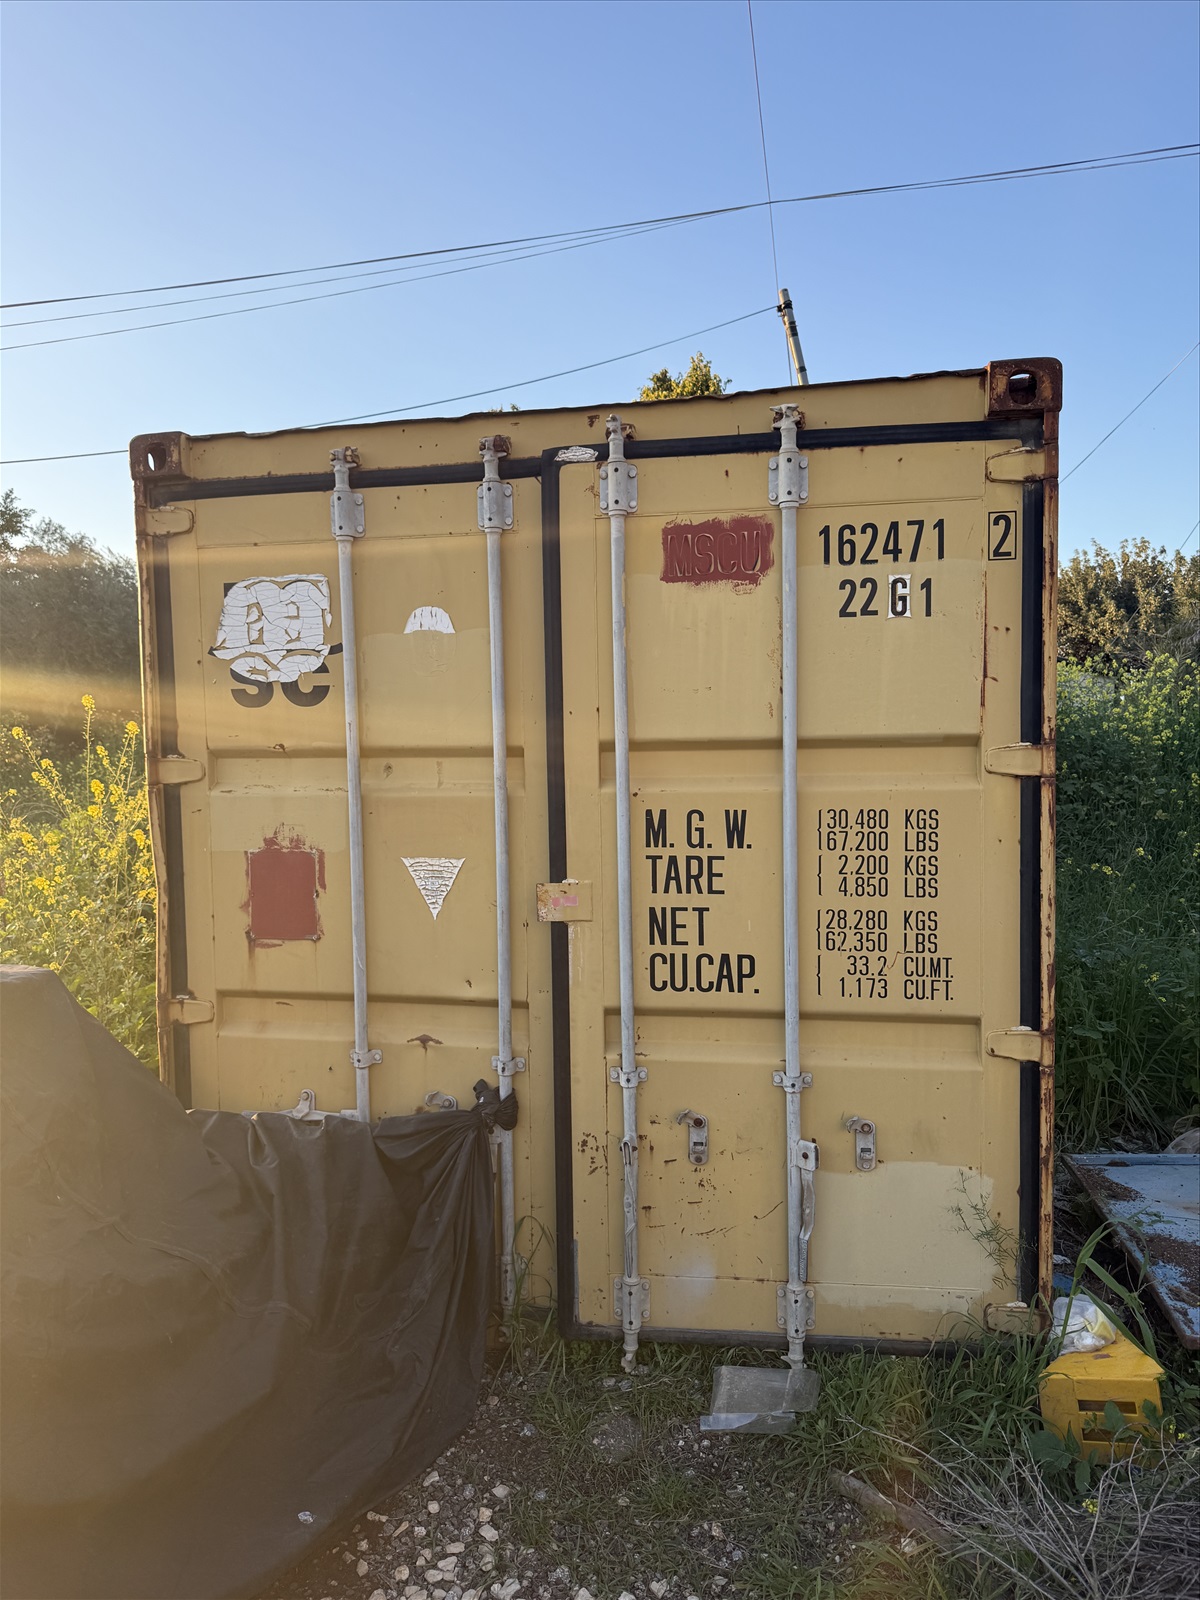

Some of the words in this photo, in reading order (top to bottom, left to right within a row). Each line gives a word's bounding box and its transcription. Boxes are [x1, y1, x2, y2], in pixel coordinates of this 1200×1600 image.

[667, 531, 761, 577] MSCU
[818, 518, 945, 566] 162471
[992, 513, 1013, 558] 2
[645, 809, 675, 849] M.
[686, 809, 713, 849] G.
[724, 809, 752, 849] W.
[826, 808, 889, 830] 30,480
[904, 808, 939, 830] KGS
[826, 830, 889, 852] 67,200
[904, 830, 939, 852] LBS
[645, 854, 725, 895] TARE
[838, 854, 889, 876] 2,200
[904, 855, 939, 876] KGS
[838, 876, 889, 898] 4,850
[904, 876, 939, 898] LBS
[648, 906, 710, 946] NET
[825, 908, 888, 931] 28,280
[903, 910, 938, 932] KGS
[825, 931, 888, 953] 62,350
[903, 932, 938, 954] LBS
[649, 952, 760, 994] CU.CAP.
[846, 955, 888, 977] 33.2
[838, 977, 888, 999] 1,173
